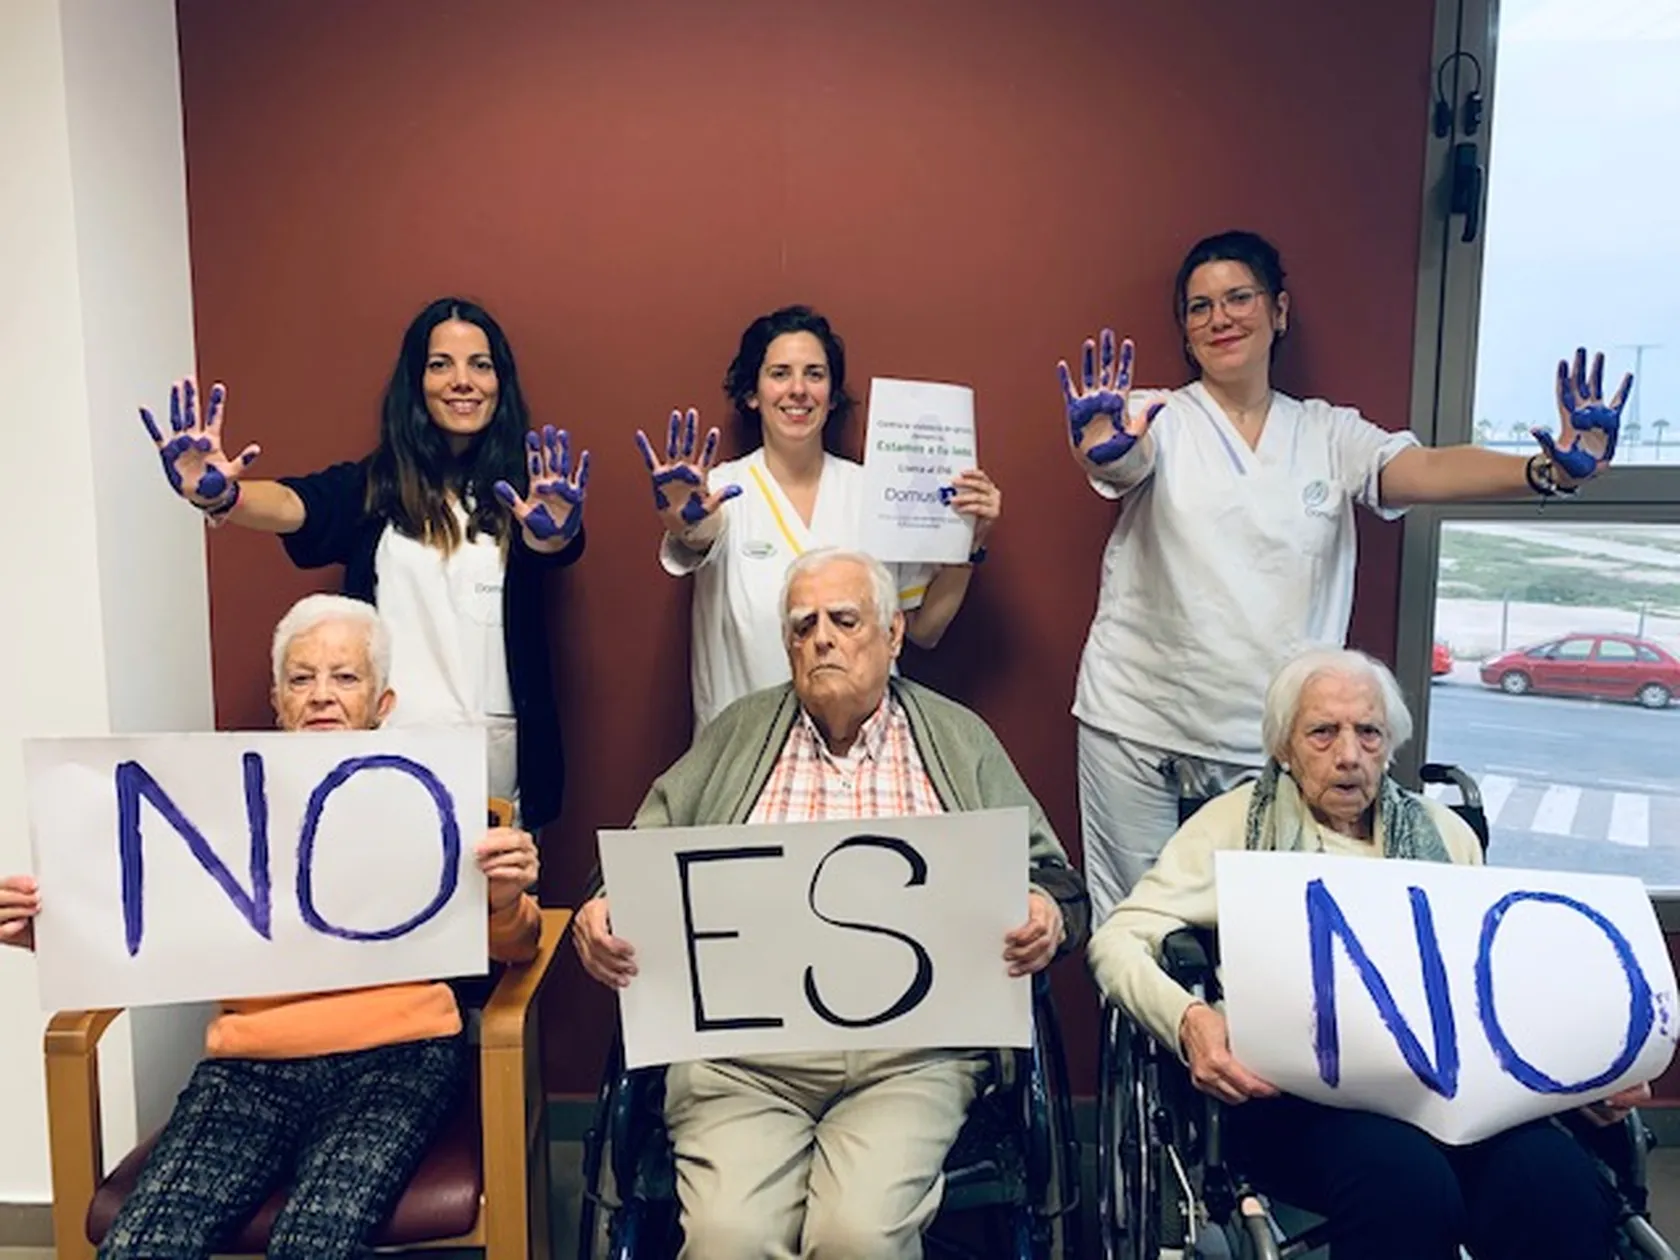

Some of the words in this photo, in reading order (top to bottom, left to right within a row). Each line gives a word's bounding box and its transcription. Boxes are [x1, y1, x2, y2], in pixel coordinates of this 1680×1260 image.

[876, 440, 924, 454] Estamos
[114, 751, 459, 957] NO
[675, 834, 932, 1031] ES
[1305, 877, 1655, 1101] NO
